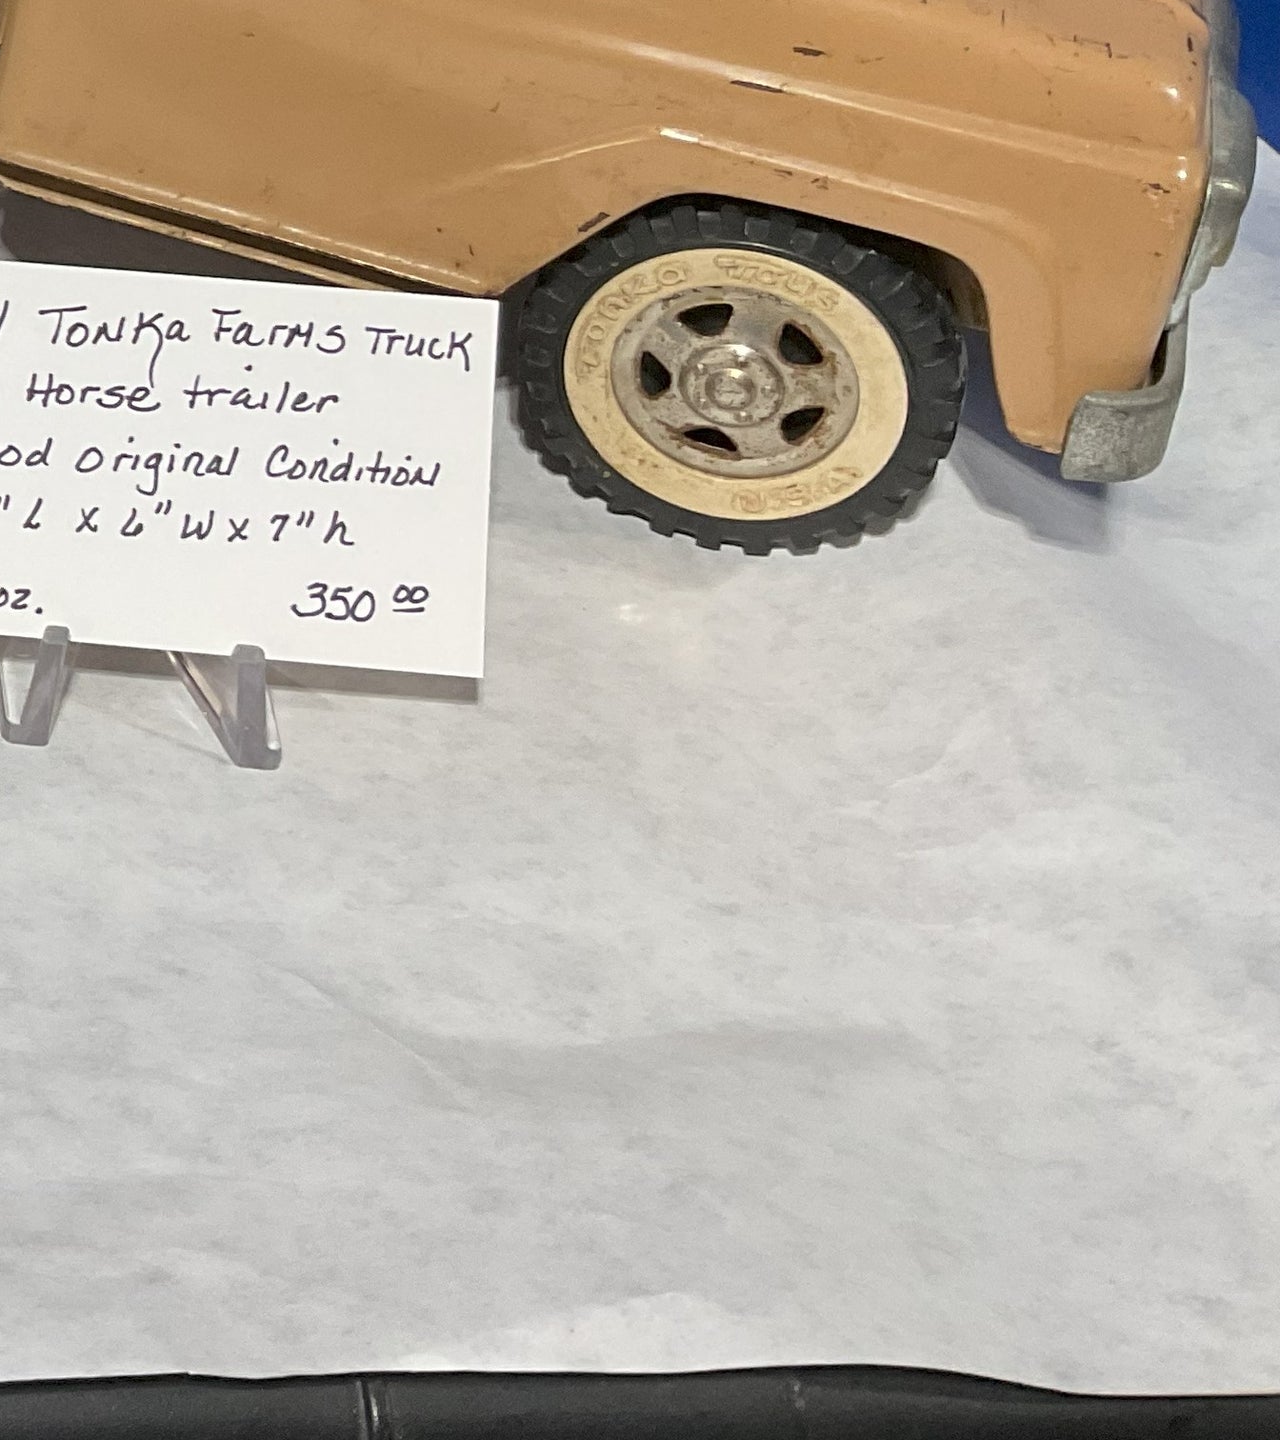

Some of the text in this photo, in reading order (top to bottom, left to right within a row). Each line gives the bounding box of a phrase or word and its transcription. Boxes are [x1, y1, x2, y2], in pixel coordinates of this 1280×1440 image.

[25, 372, 162, 412] Horse
[183, 364, 341, 414] trailer
[264, 438, 442, 488] Condition
[290, 582, 377, 623] 350
